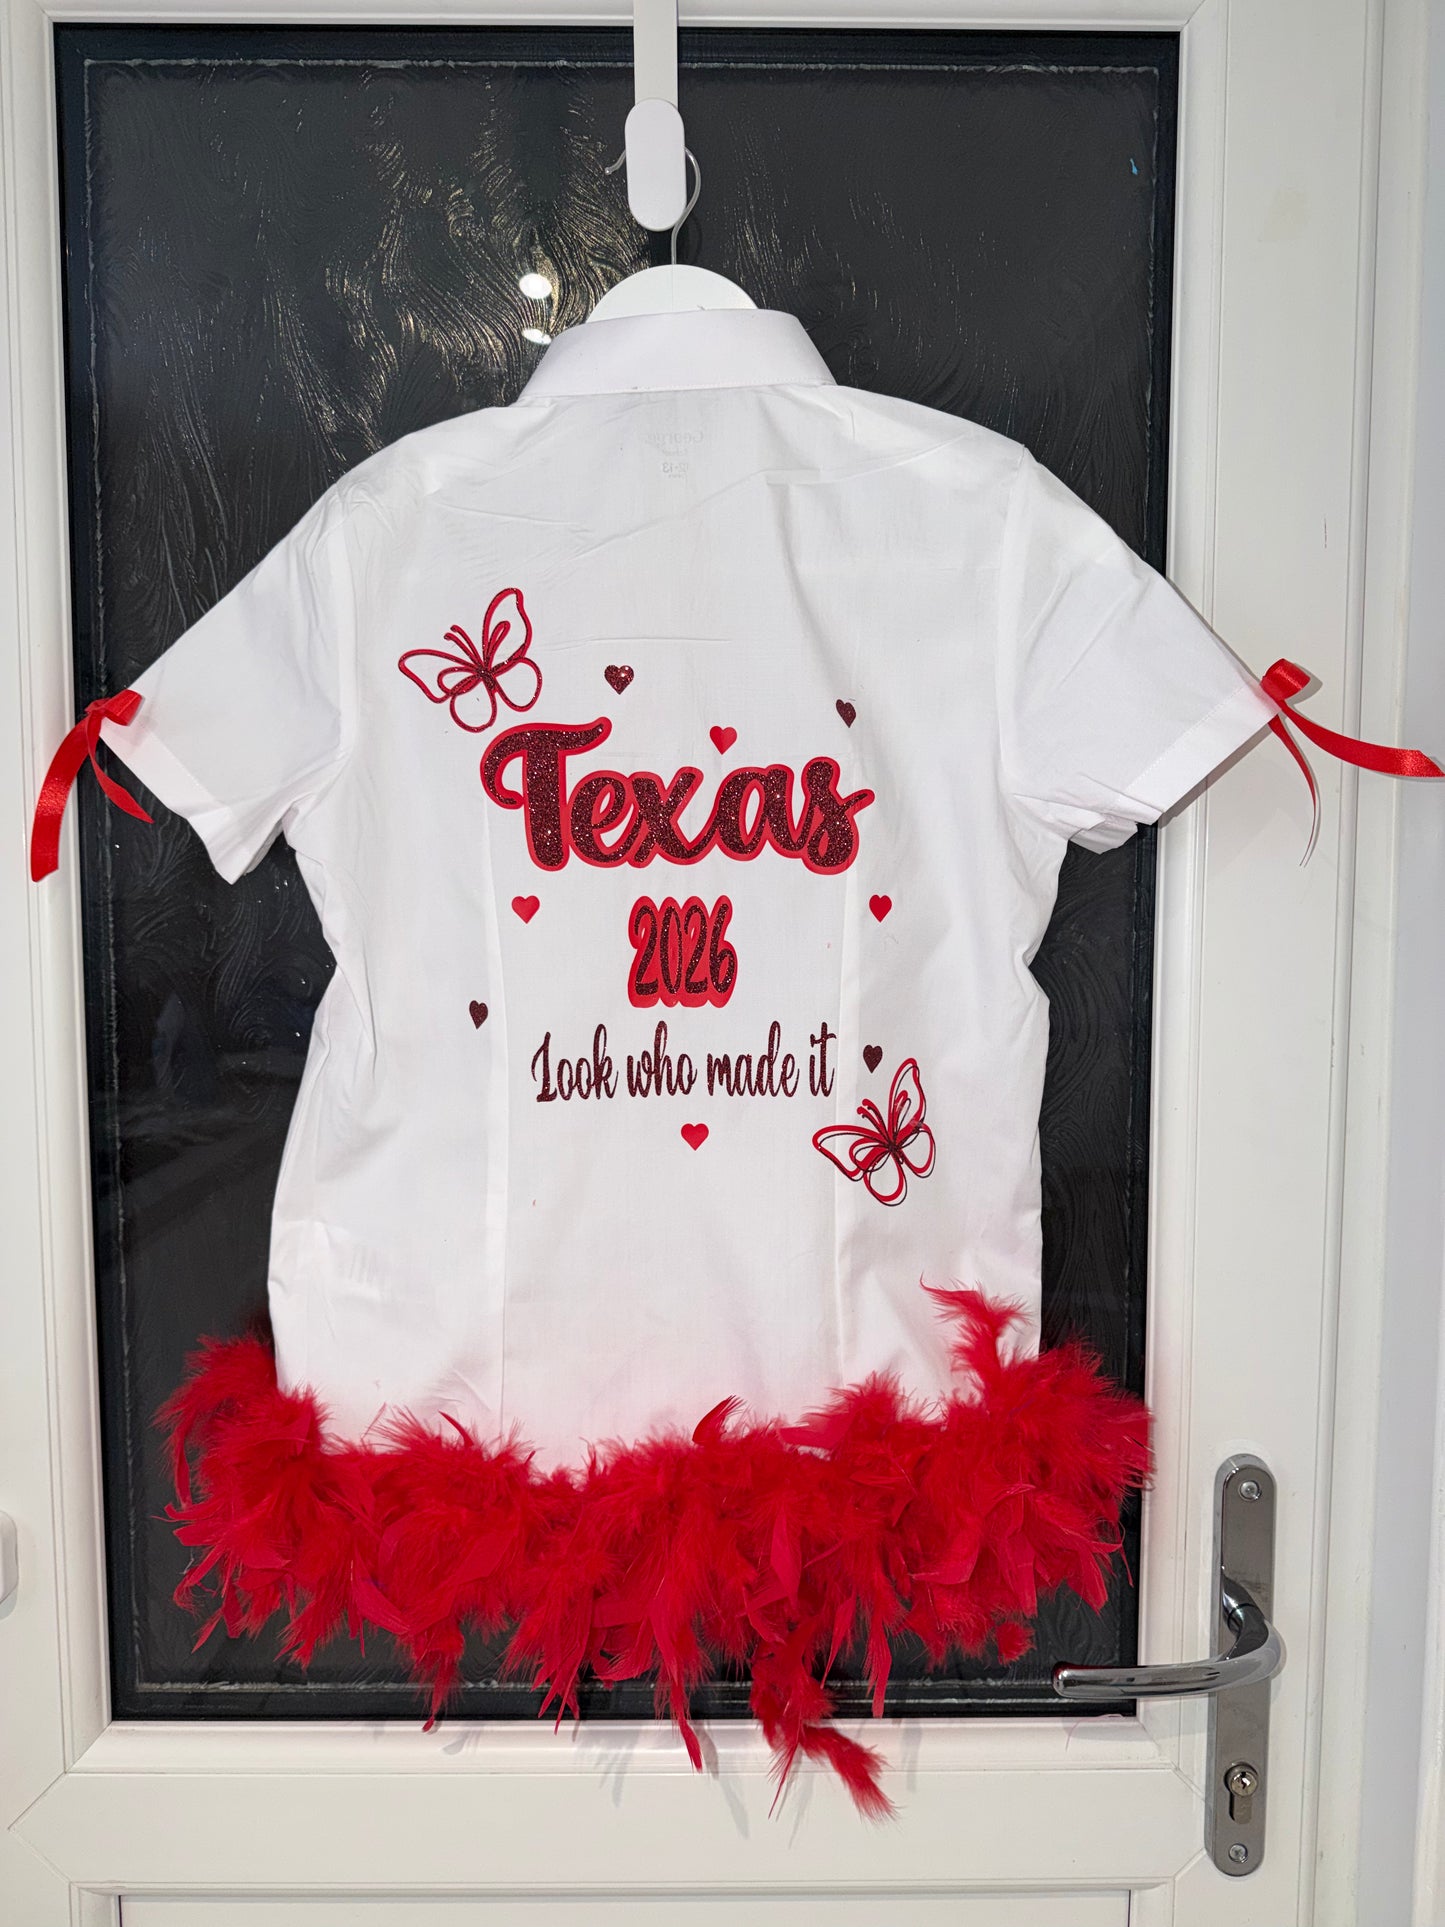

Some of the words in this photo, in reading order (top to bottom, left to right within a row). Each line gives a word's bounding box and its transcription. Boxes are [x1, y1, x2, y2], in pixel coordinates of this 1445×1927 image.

[480, 717, 875, 875] Texas
[627, 895, 738, 1008] 2026
[531, 1024, 618, 1102] Look
[626, 1021, 698, 1099] who
[707, 1021, 800, 1098] made
[809, 1022, 837, 1099] it
